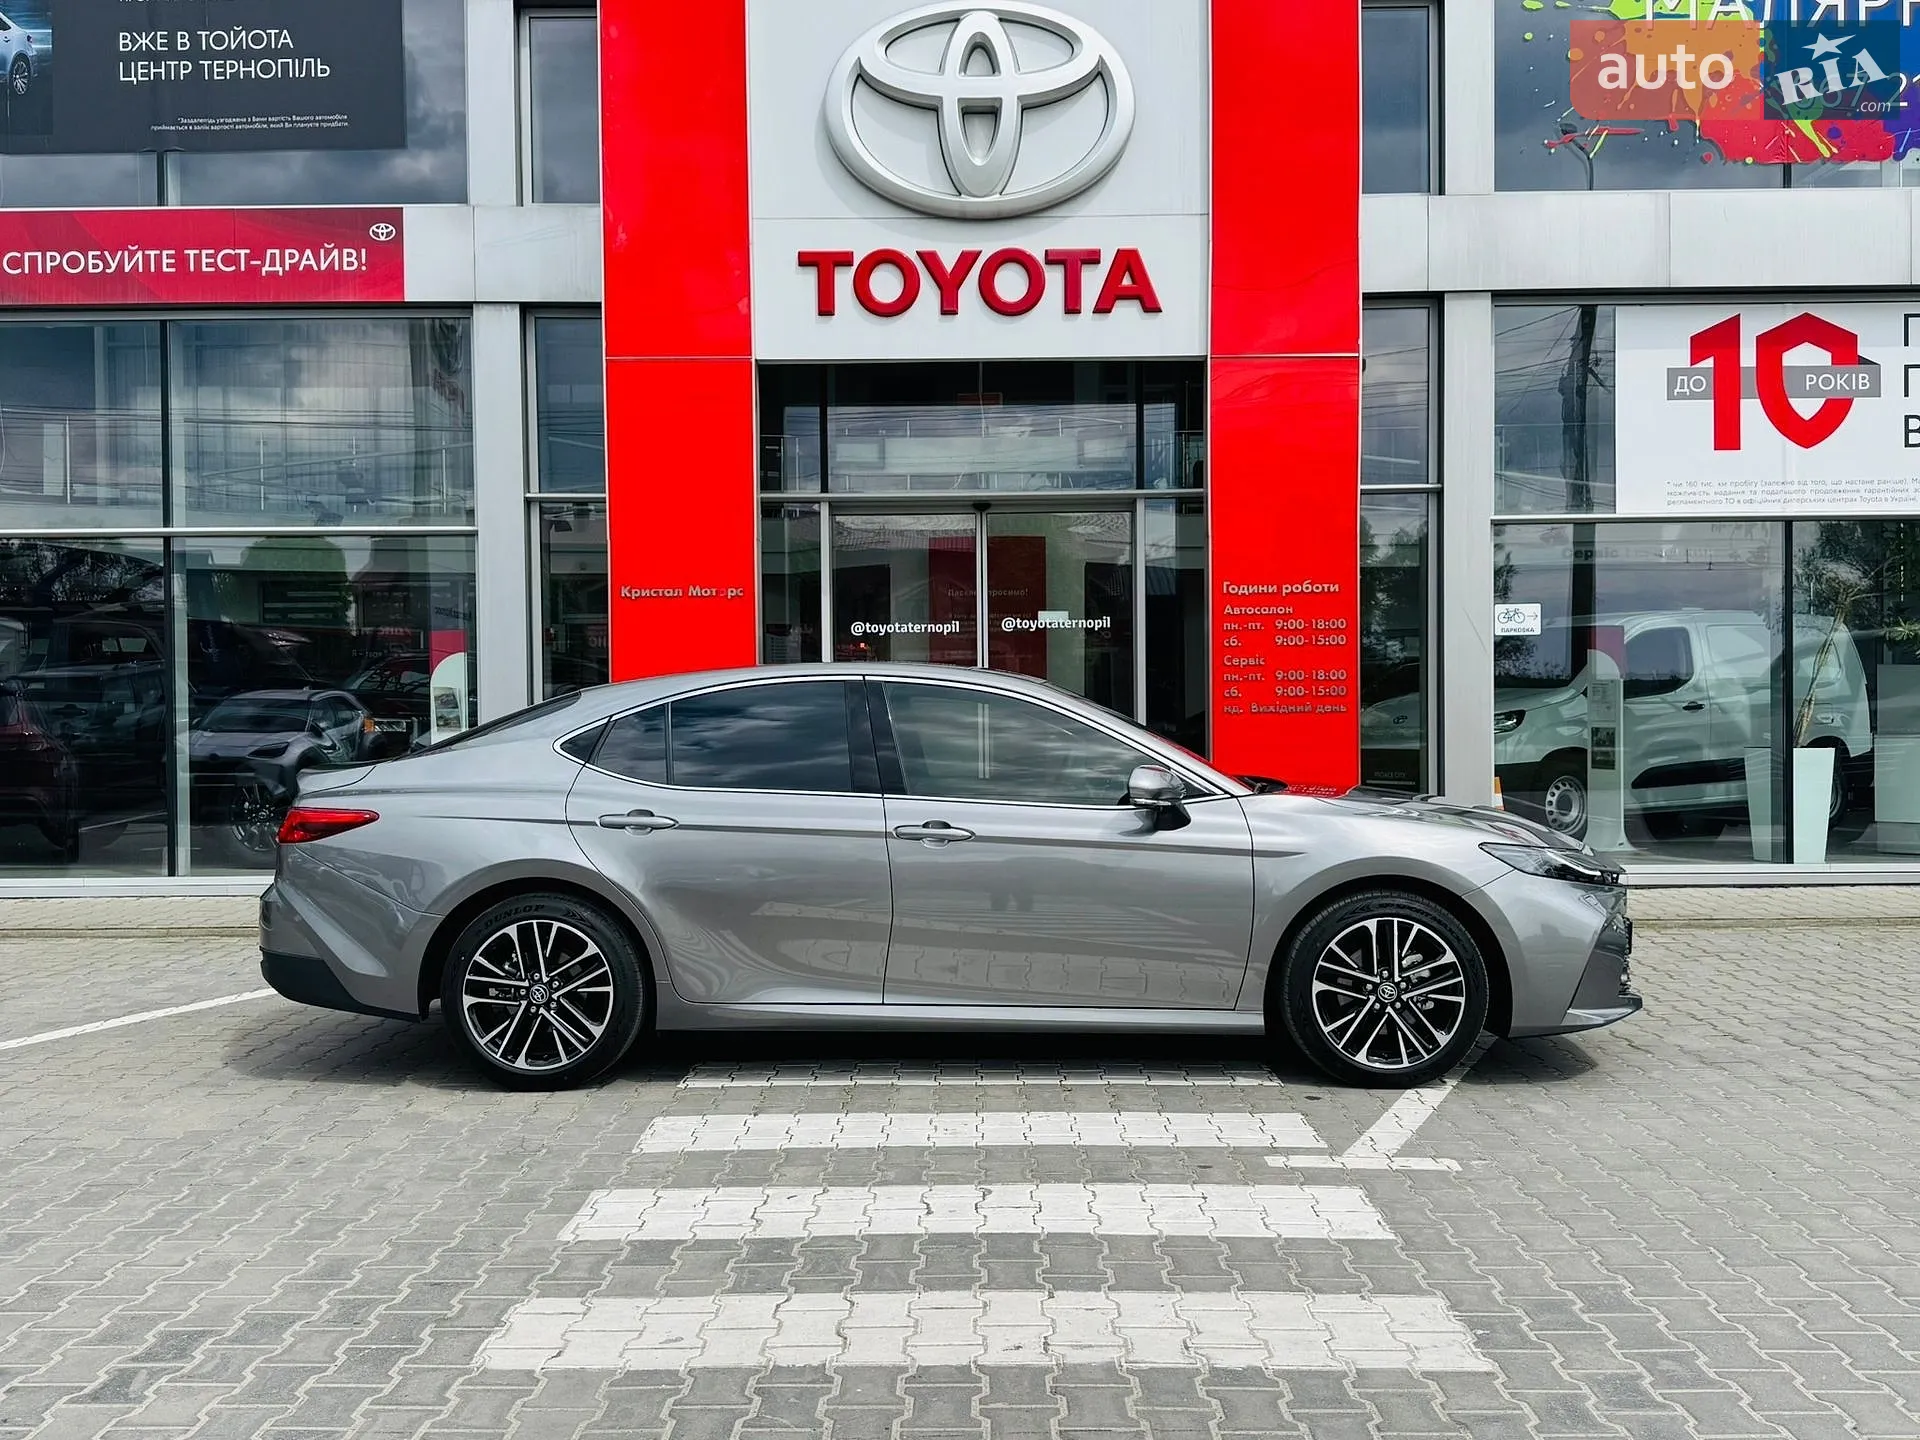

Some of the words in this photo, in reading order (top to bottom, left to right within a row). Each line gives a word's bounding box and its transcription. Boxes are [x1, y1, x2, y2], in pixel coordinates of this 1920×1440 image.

[119, 30, 168, 52] ВЖЕ
[177, 30, 191, 51] В
[197, 26, 294, 51] ТОЙОТА
[119, 60, 192, 85] ЦЕНТР
[199, 57, 331, 81] ТЕРНОПІЛЬ
[2, 245, 175, 275] СПРОБУЙТЕ
[184, 243, 367, 276] ТЕСТ-ДРАЙВ!
[797, 247, 1163, 317] TOYOTA
[1674, 375, 1707, 395] ДО
[1690, 312, 1858, 450] 10
[1805, 374, 1870, 391] РОКІВ
[621, 585, 683, 599] Кристал
[1223, 581, 1277, 595] Години
[1282, 579, 1340, 596] роботи
[1224, 604, 1293, 615] Автосалон
[850, 620, 960, 636] @toyotaternopil
[1001, 616, 1111, 633] @toyotaternopil
[1224, 636, 1242, 647] сб.
[1224, 654, 1265, 668] Сервіс
[1224, 686, 1243, 697] сб.
[1251, 702, 1312, 714] Вихідний
[1316, 705, 1347, 713] день
[484, 904, 545, 928] DUNLOP
